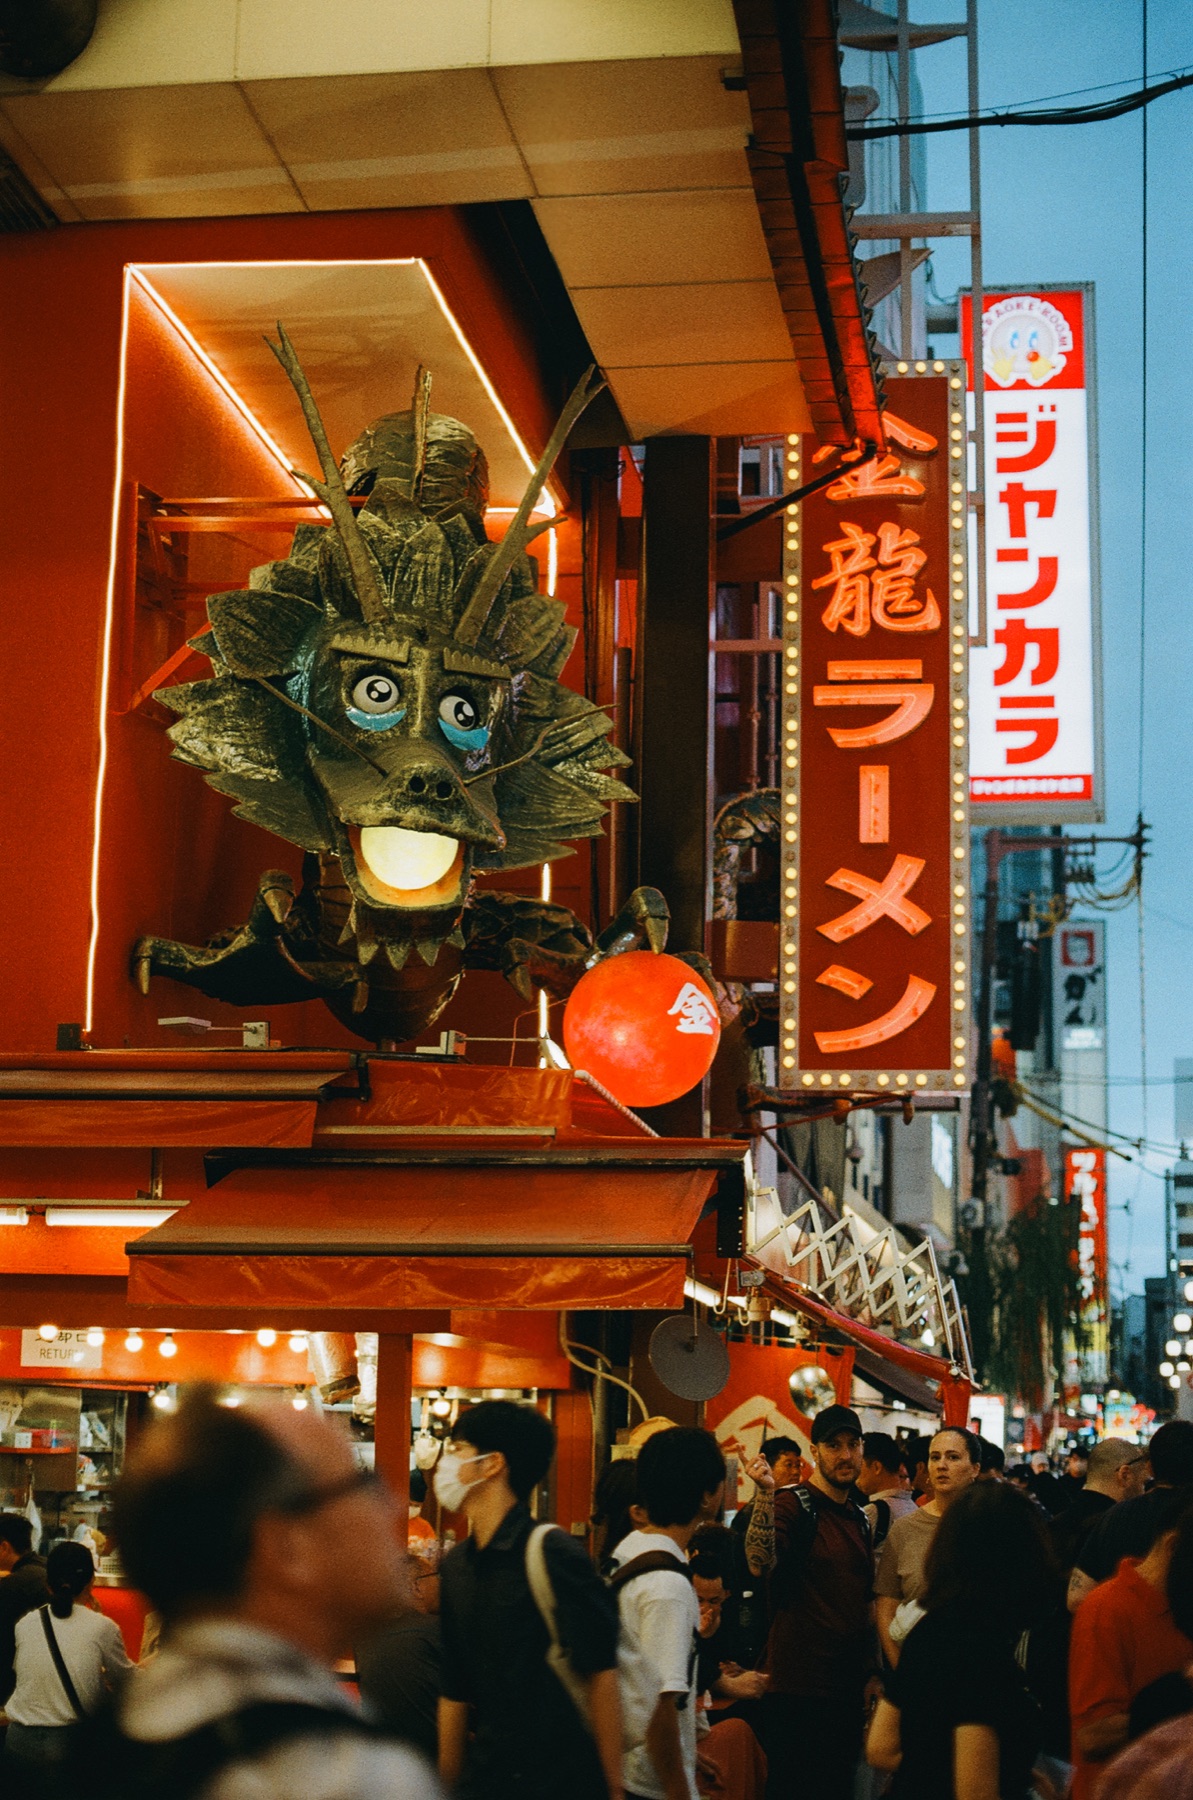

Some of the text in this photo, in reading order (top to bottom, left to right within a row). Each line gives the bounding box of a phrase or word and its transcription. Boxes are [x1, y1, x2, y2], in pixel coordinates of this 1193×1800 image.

[811, 410, 941, 1053] 金龍ラーメン
[993, 404, 1060, 765] ジャンカラ
[667, 982, 717, 1034] 金
